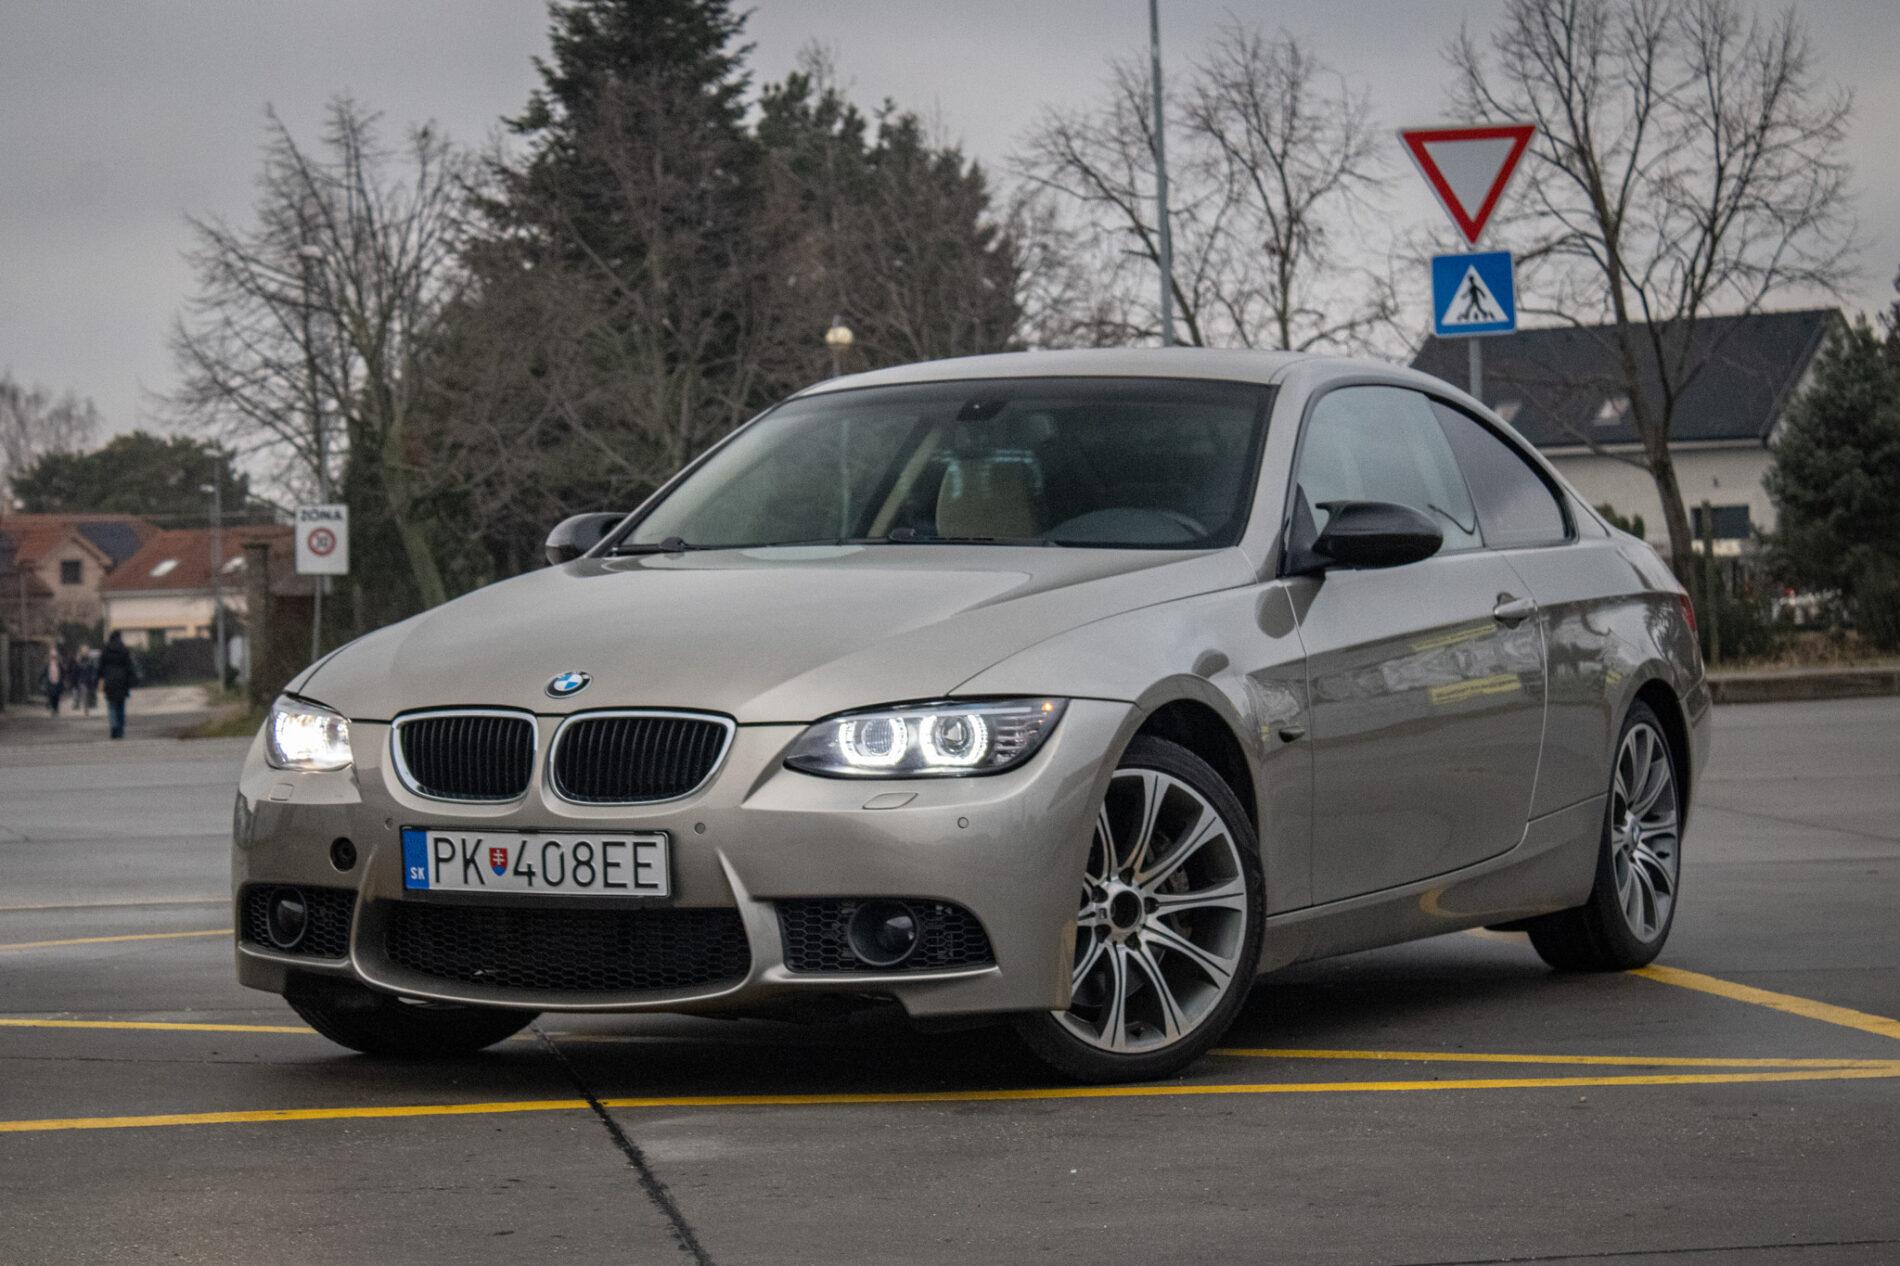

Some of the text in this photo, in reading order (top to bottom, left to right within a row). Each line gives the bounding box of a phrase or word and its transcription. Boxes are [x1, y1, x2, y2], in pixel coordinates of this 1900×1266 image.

[301, 509, 343, 522] ZONA
[433, 837, 659, 889] PK 408EE
[410, 867, 426, 880] SK
